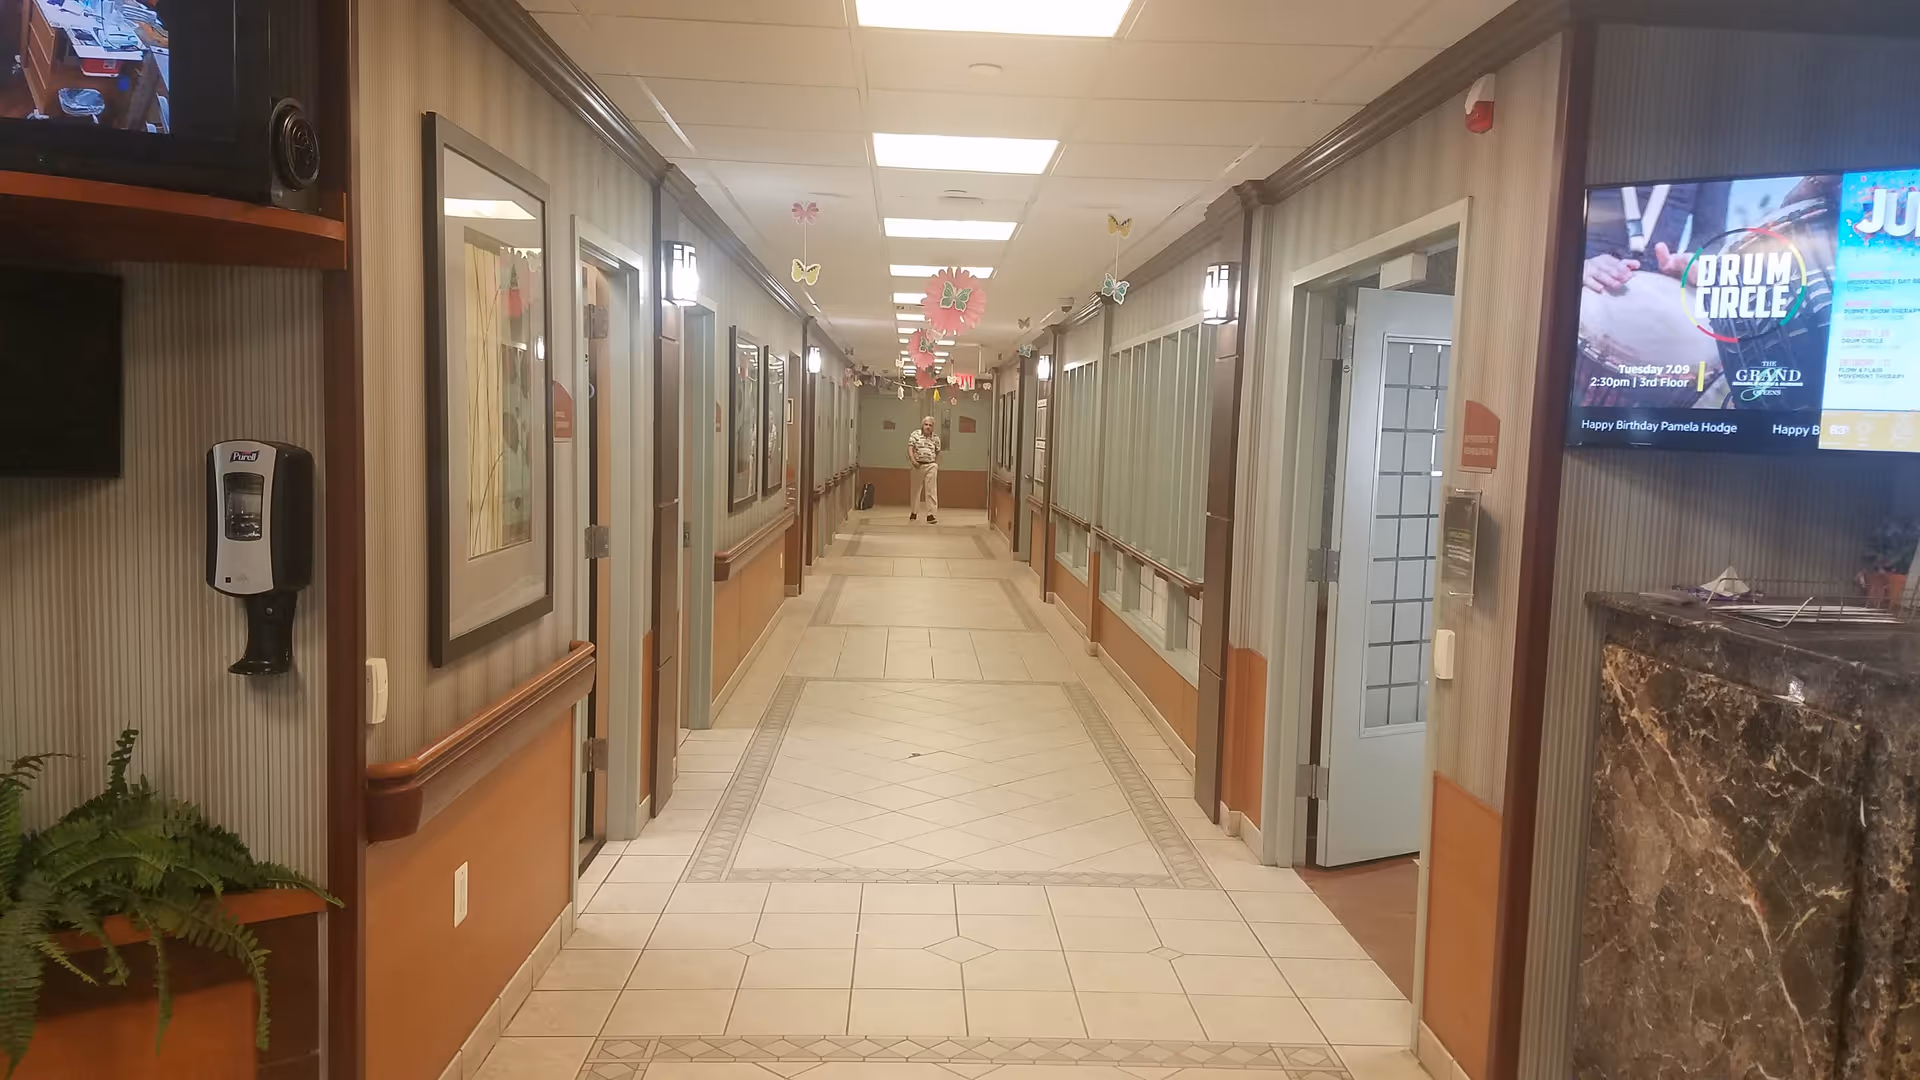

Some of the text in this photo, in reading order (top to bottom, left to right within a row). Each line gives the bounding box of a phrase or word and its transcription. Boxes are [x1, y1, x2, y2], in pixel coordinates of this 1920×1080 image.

[1855, 188, 1920, 237] JU
[1697, 252, 1792, 287] DRUM
[1695, 285, 1790, 319] CIRCLE
[1618, 364, 1690, 375] Tuesday 7.09
[1735, 369, 1802, 382] GRAND
[1590, 377, 1630, 388] 2:30pm
[1639, 377, 1657, 387] 3rd
[1660, 378, 1690, 387] Floor
[1581, 420, 1738, 435] Happy Birthday Pamela Hodge
[1772, 424, 1810, 437] Happy
